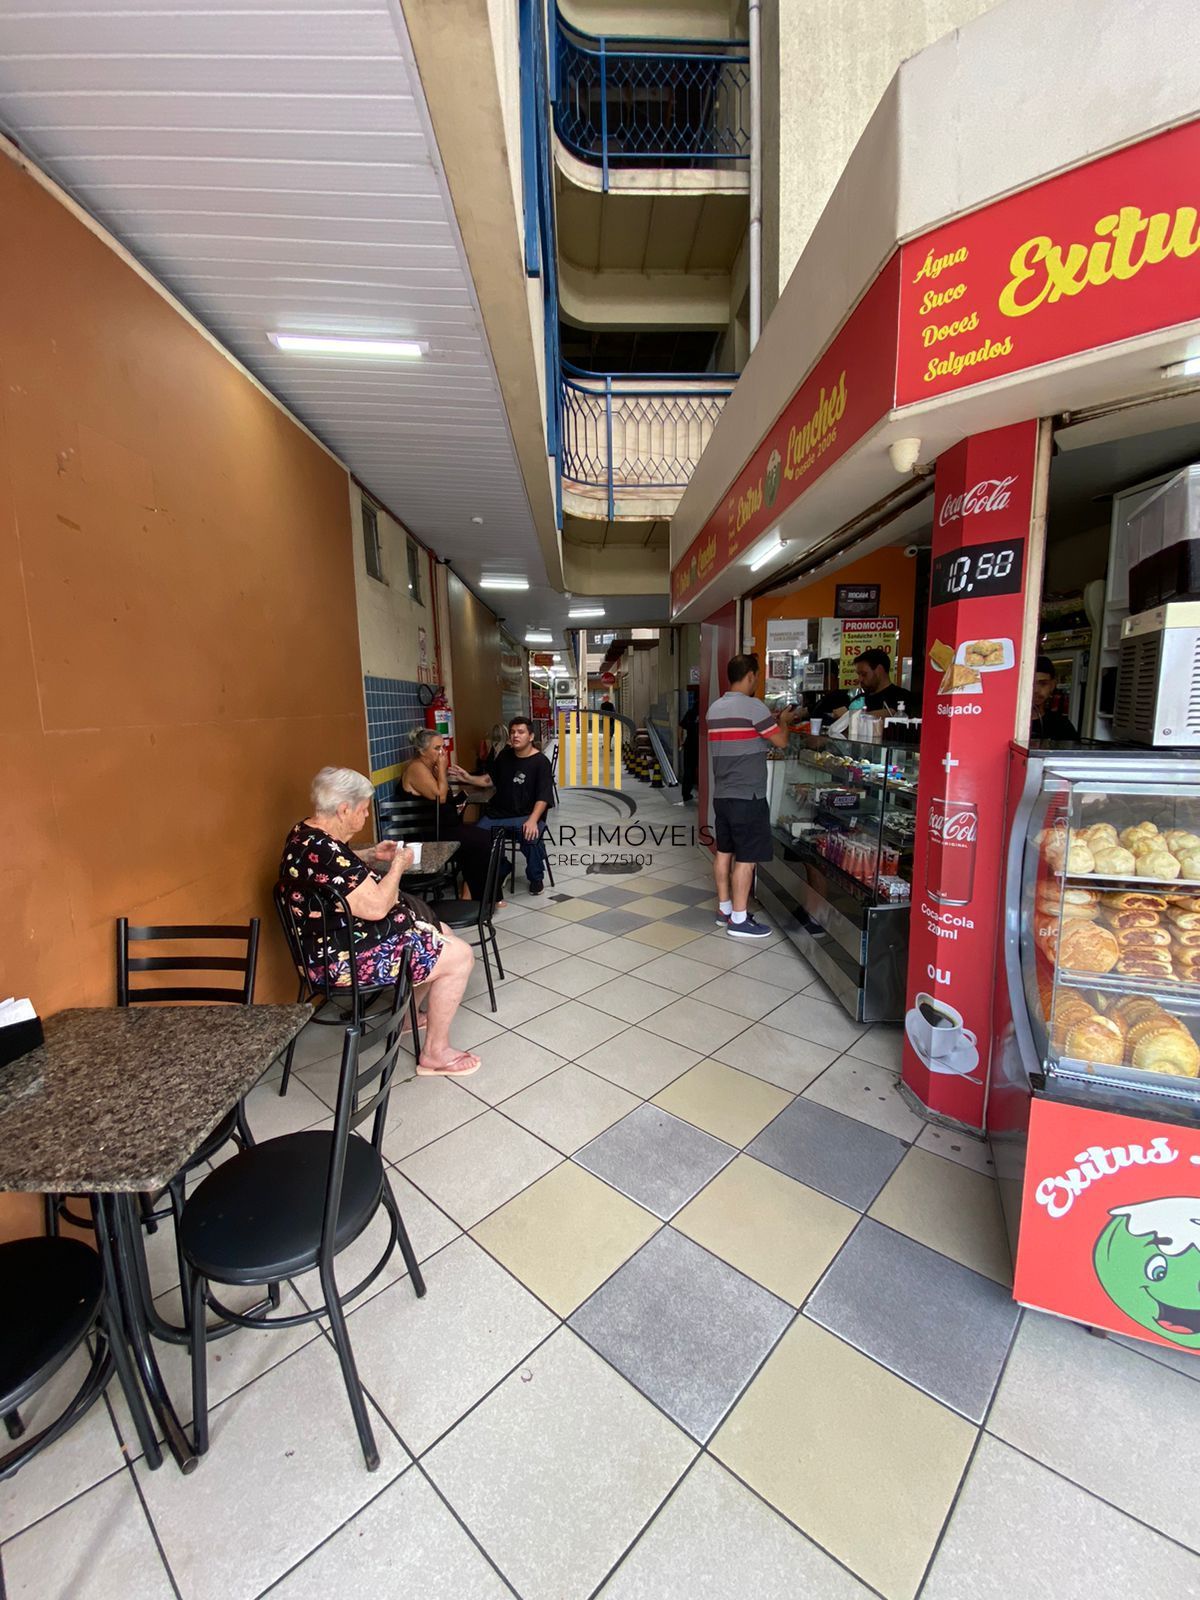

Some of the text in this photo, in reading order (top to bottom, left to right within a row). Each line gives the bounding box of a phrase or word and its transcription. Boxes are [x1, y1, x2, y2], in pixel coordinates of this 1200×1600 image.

[912, 246, 969, 283] Água
[998, 206, 1200, 317] Exitu
[919, 283, 968, 315] Suco
[921, 311, 980, 348] Doces
[923, 335, 1014, 382] Salgados
[784, 370, 848, 480] Lanches
[845, 620, 894, 631] PROMOÇÃO
[937, 703, 982, 717] Salgado
[921, 902, 975, 930] Coca-Cola
[927, 920, 958, 940] 220ml
[927, 964, 951, 985] ou
[1035, 1137, 1179, 1218] Exitus
